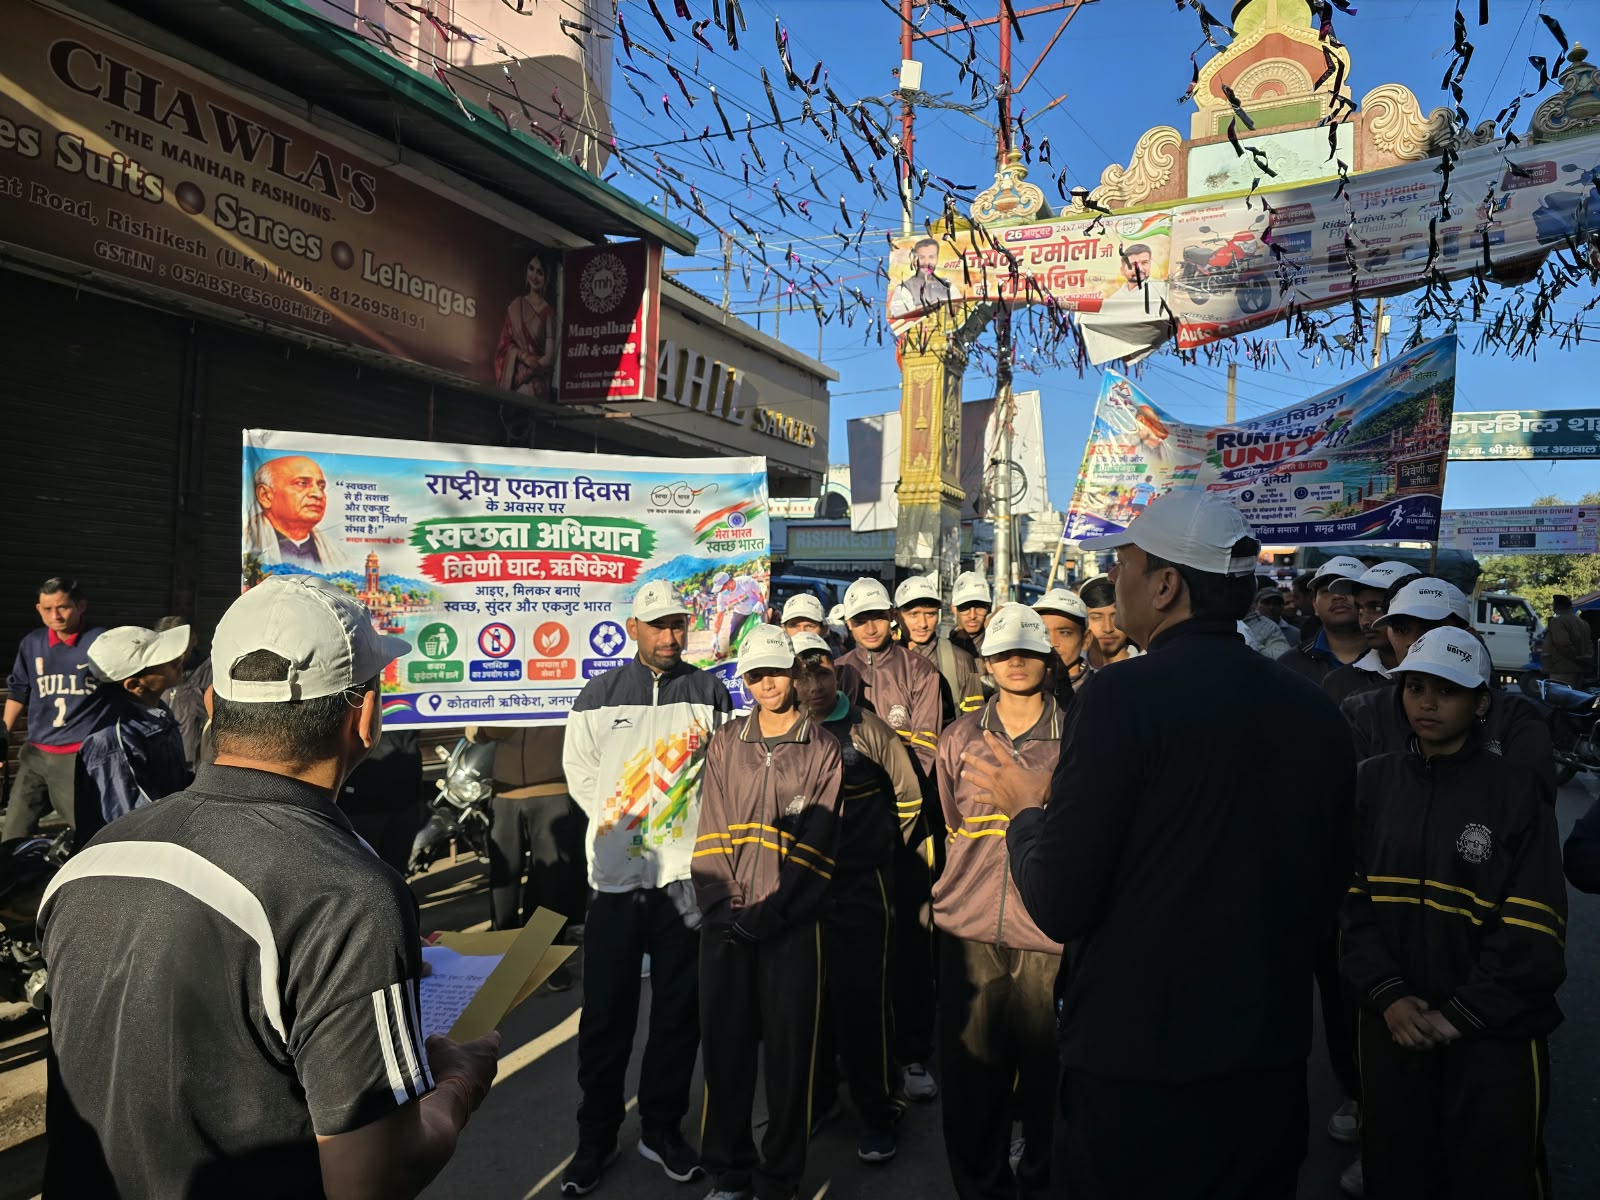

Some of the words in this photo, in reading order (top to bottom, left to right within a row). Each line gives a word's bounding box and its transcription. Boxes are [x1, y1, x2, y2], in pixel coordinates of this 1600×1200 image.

[48, 38, 377, 215] CHAWLA'S
[161, 141, 246, 188] MANHAR
[1359, 190, 1381, 200] The
[1385, 182, 1426, 197] Honda
[1391, 192, 1418, 203] Fest
[55, 131, 164, 204] Suits
[214, 192, 322, 262] Sarees
[361, 249, 477, 318] Lehengas
[1007, 230, 1023, 240] 26
[29, 182, 98, 225] Road,
[107, 208, 208, 258] Rishikesh
[215, 246, 269, 282] (U.K.)
[329, 285, 426, 331] 8126958191
[94, 240, 153, 272] GSTIN
[1030, 236, 1103, 265] रमोला
[1100, 244, 1114, 258] जी
[568, 319, 637, 338] Mangalhari
[1180, 326, 1213, 343] Auto
[568, 343, 589, 357] silk
[591, 344, 601, 357] &
[602, 342, 636, 355] saree
[1265, 393, 1347, 429] ऋषिकेश
[757, 406, 818, 449] SAREES
[1217, 432, 1270, 451] RUN
[1275, 425, 1318, 440] FOR
[1222, 431, 1328, 468] UNITY
[1489, 444, 1503, 455] श्री
[1505, 445, 1523, 456] प्रेम
[1551, 446, 1596, 455] अग्रवाल
[1401, 463, 1425, 477] त्रिवेणी
[425, 470, 500, 500] राष्ट्रीय
[506, 478, 569, 500] एकता
[573, 475, 631, 502] दिवस
[1261, 473, 1292, 487] यूनिटी
[344, 491, 351, 500] से
[354, 492, 362, 502] ही
[365, 494, 390, 502] सशक्त
[345, 502, 360, 511] और
[363, 504, 390, 514] एकजुट
[486, 498, 499, 512] के
[504, 501, 543, 513] अवसर
[550, 503, 565, 513] पर
[345, 515, 366, 523] भारत
[381, 513, 408, 524] निर्माण
[344, 524, 365, 533] संभव
[425, 523, 531, 551] स्वच्छता
[536, 518, 642, 552] अभियान
[715, 527, 729, 539] मेरा
[731, 528, 752, 539] भारत
[1278, 525, 1299, 534] समाज
[1337, 522, 1356, 531] भारत
[706, 540, 736, 553] स्वच्छ
[738, 539, 765, 550] भारत
[443, 554, 502, 580] त्रिवेणी
[506, 558, 546, 579] घाट,
[550, 554, 625, 580] ऋषिकेश
[475, 586, 509, 598] आइए,
[513, 583, 551, 597] मिलकर
[555, 584, 581, 597] बनाएं
[444, 601, 480, 614] स्वच्छ,
[485, 599, 512, 616] सुंदर
[516, 597, 537, 613] और
[542, 601, 580, 615] एकजुट
[584, 601, 612, 612] भारत
[1447, 645, 1466, 658] UNITY
[37, 674, 97, 698] BULLS
[447, 695, 495, 708] कोतवाली
[499, 692, 544, 708] ऋषिकेश,
[53, 697, 67, 727] 1
